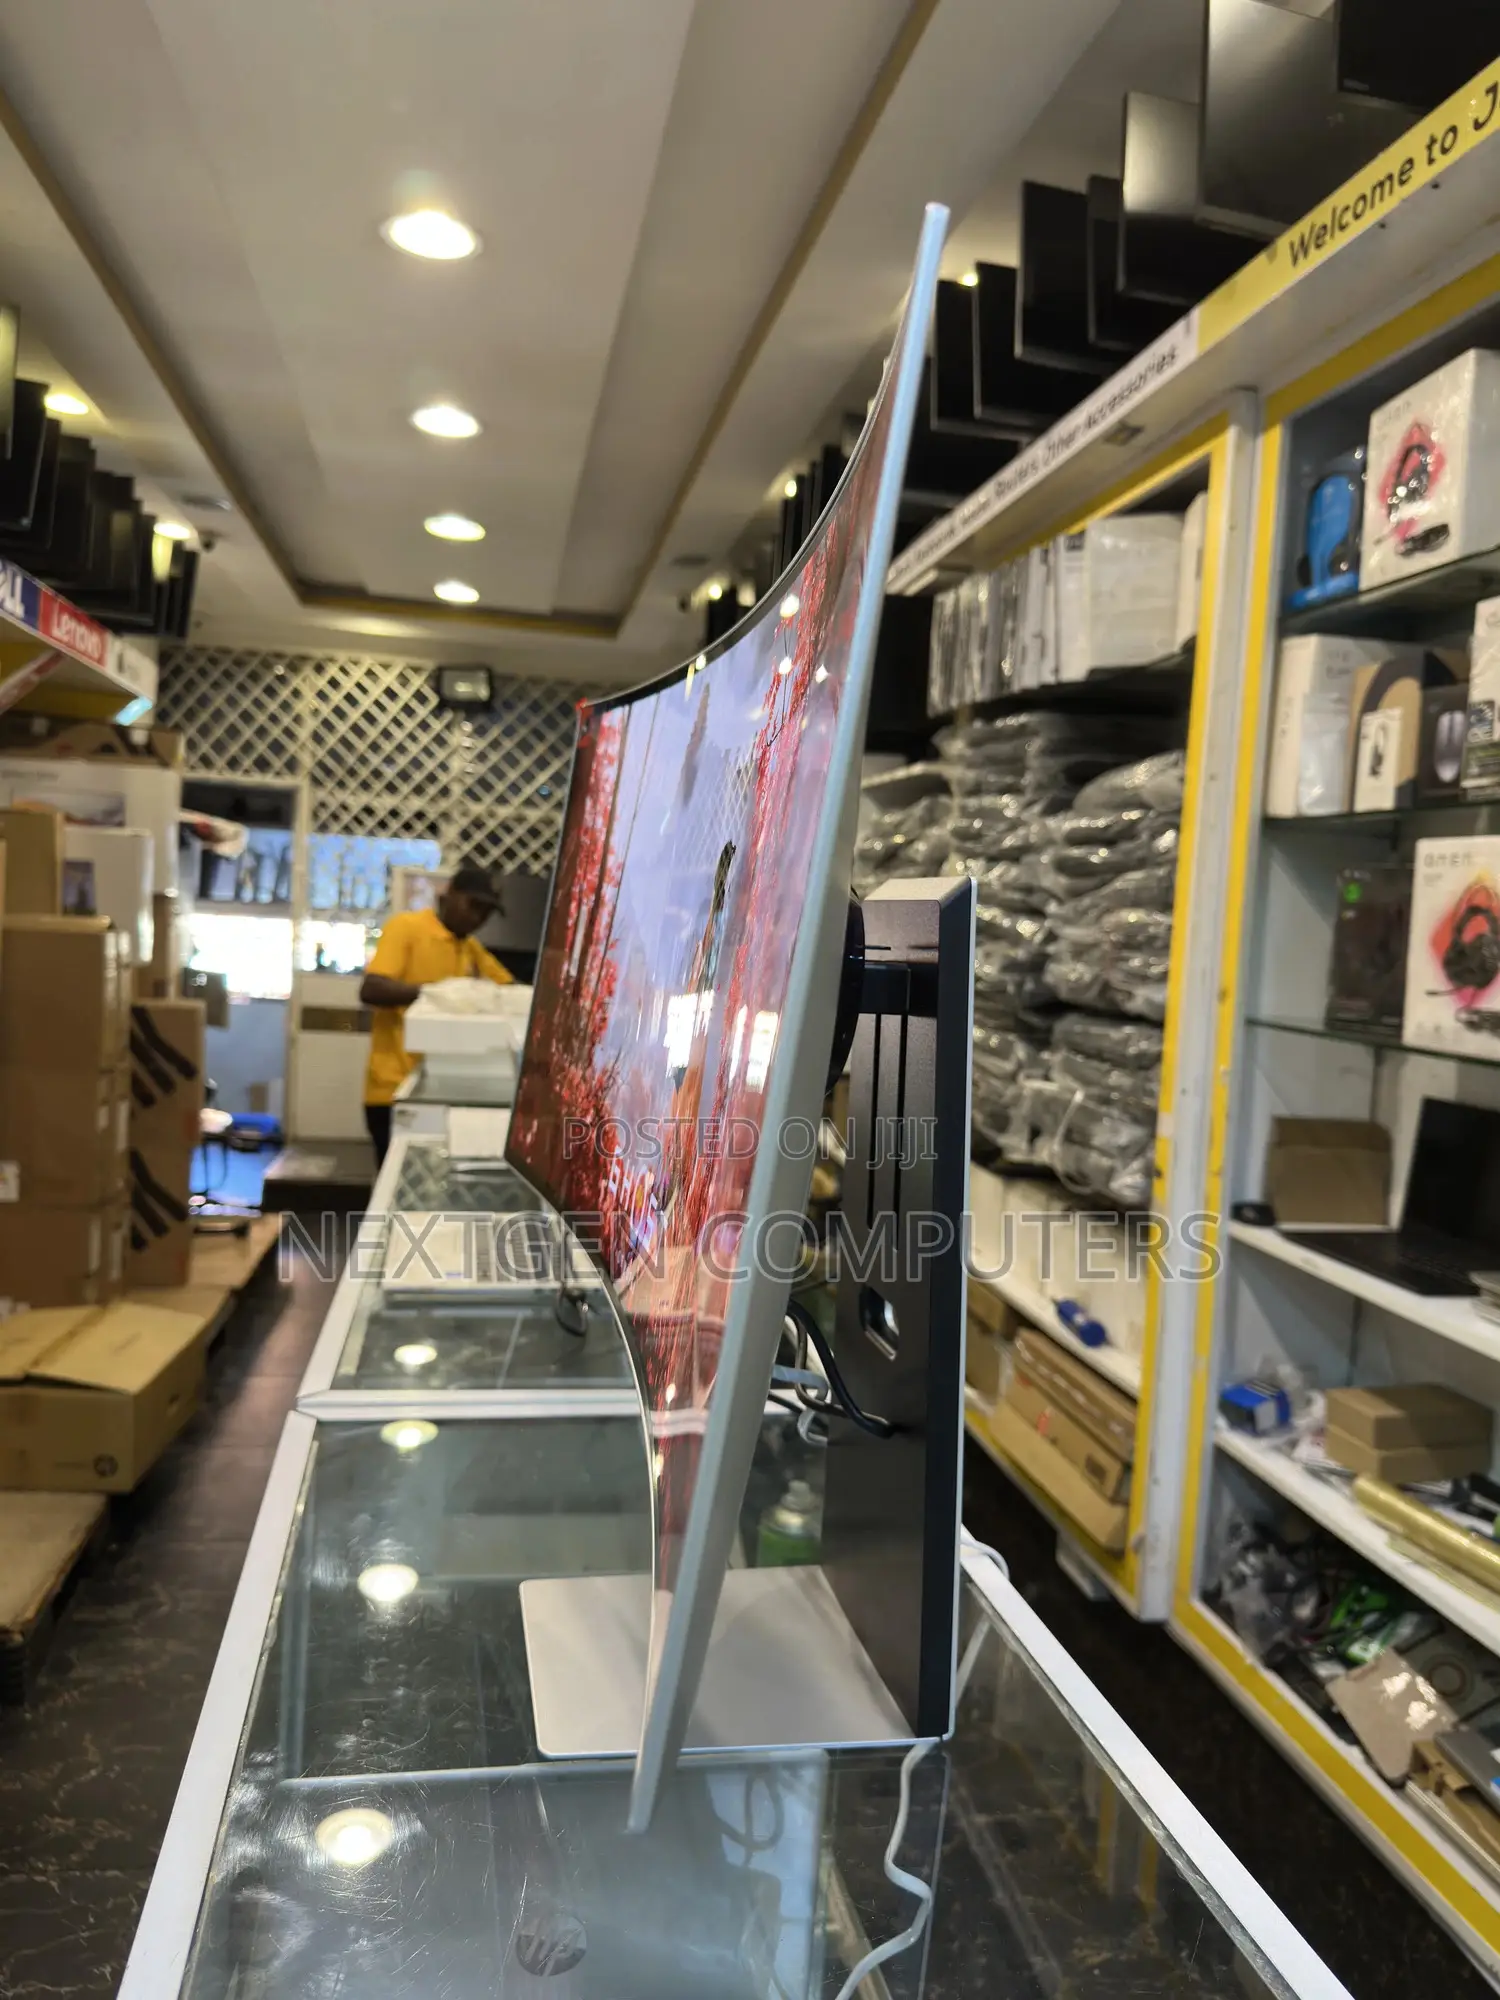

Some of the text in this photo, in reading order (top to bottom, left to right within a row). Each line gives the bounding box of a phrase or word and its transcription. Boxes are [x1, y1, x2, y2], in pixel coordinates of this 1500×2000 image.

[1288, 80, 1500, 267] Welcome to J
[52, 600, 102, 661] Lenovo
